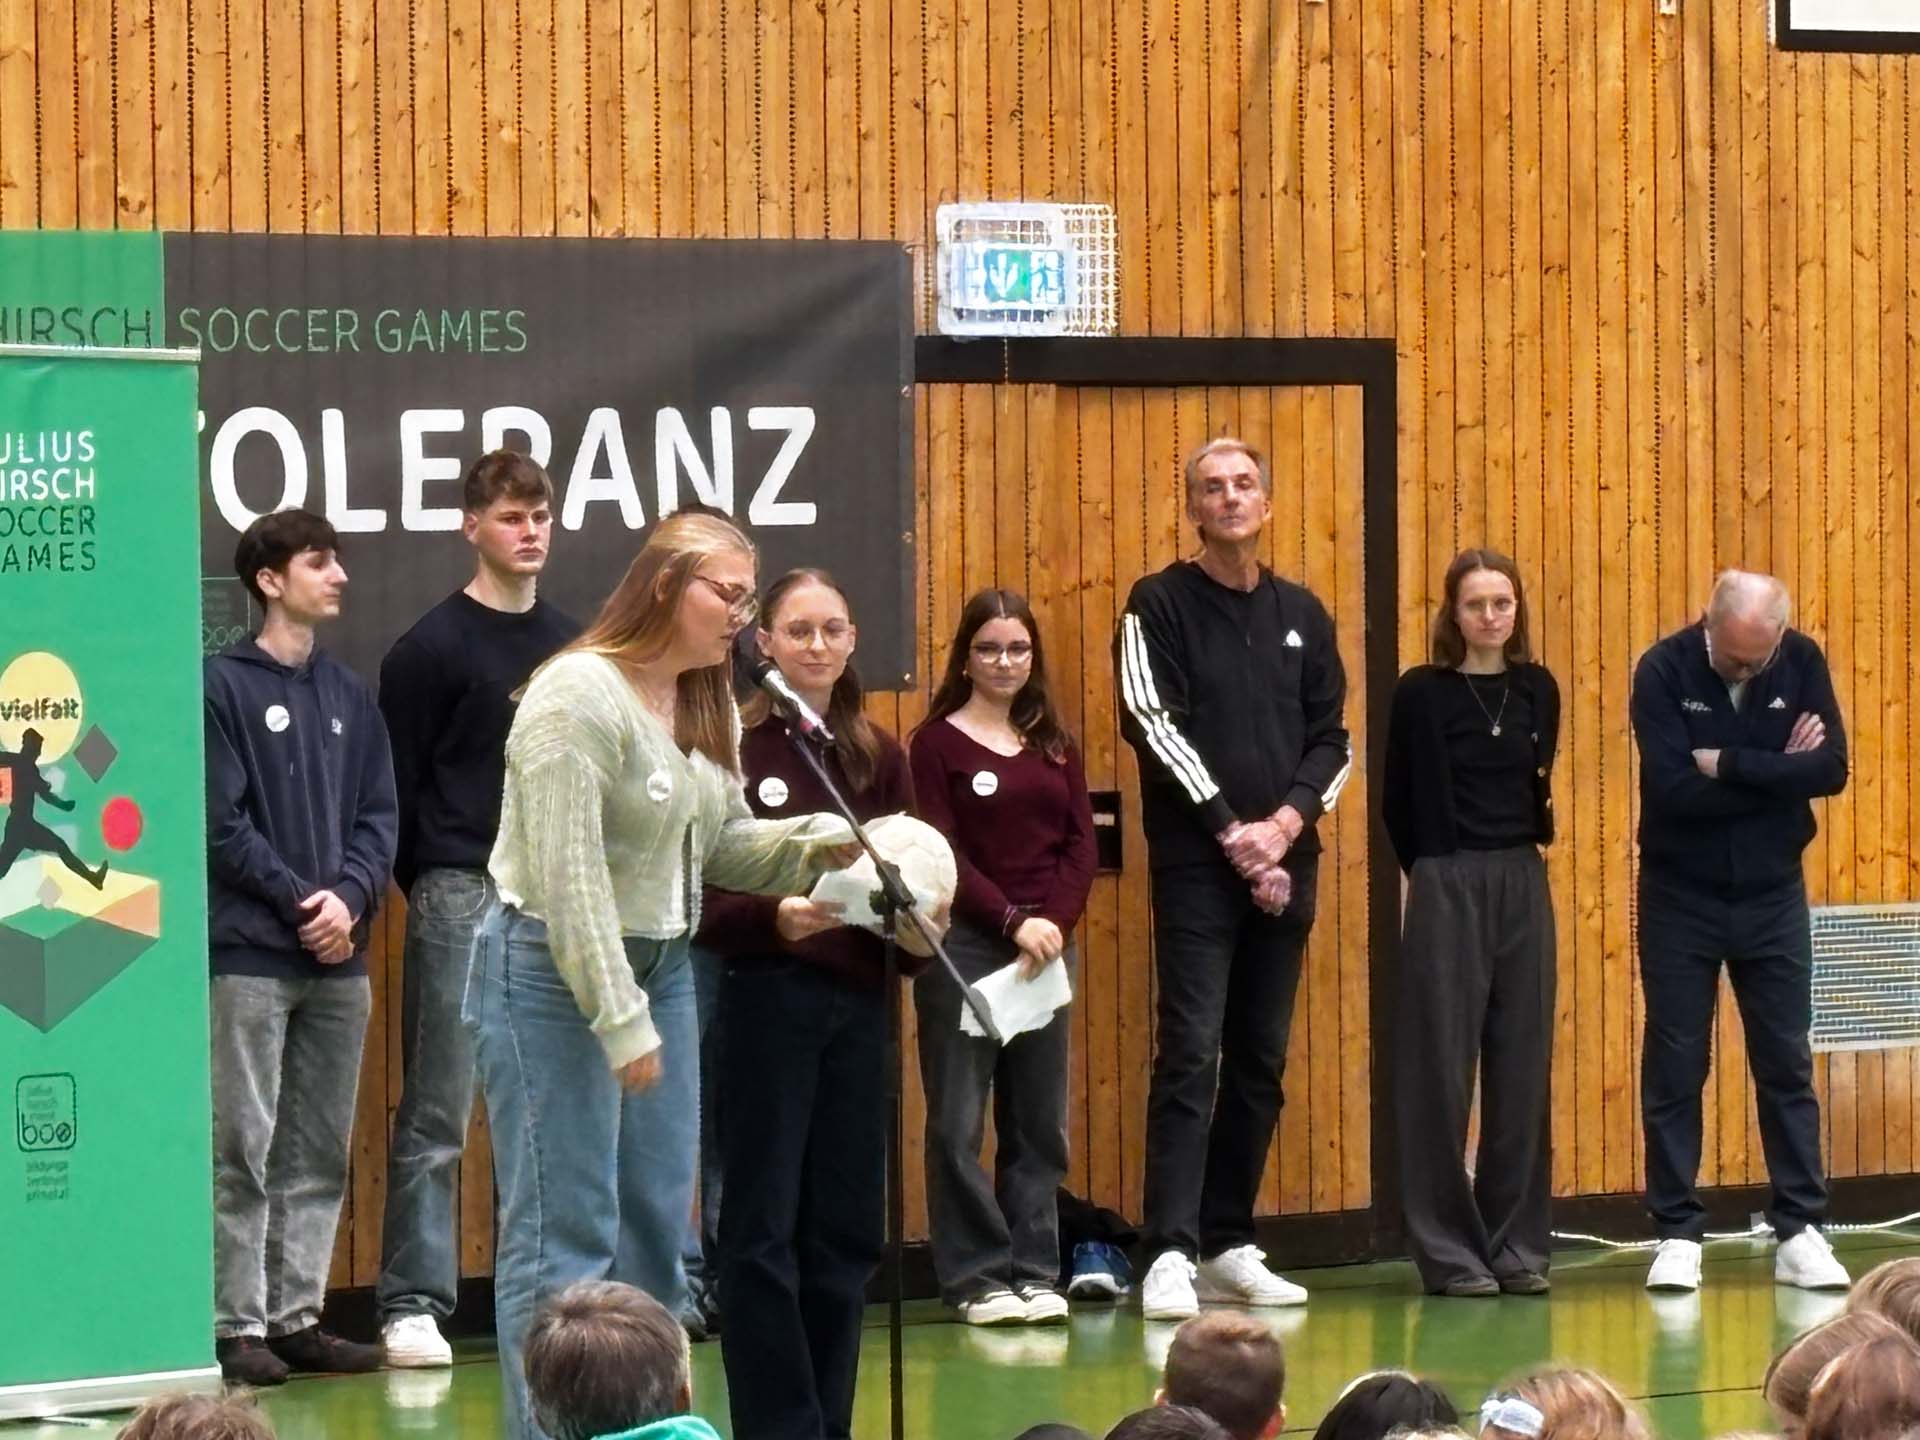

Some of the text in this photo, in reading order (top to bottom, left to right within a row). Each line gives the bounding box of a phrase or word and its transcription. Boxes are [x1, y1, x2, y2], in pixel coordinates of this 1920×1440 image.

[178, 307, 361, 352] SOCCER
[374, 308, 528, 353] GAMES
[197, 406, 818, 534] OLEANZ
[1, 540, 96, 573] AMES
